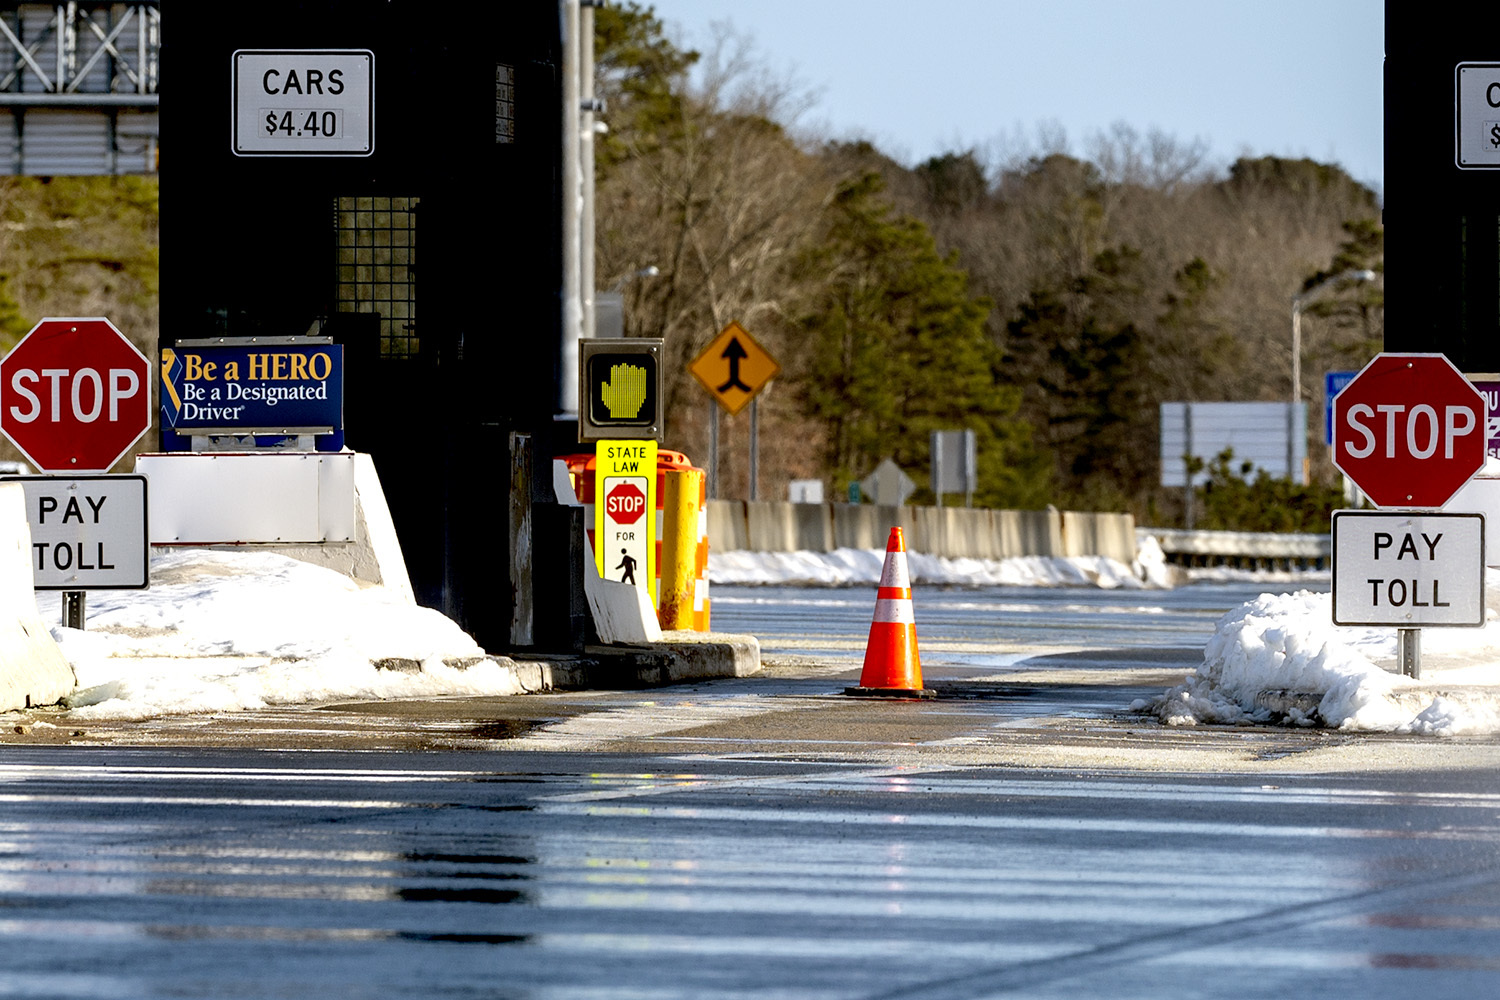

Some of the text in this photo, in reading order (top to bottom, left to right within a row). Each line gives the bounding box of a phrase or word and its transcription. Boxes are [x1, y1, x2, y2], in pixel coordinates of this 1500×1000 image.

[262, 68, 345, 96] CARS
[265, 110, 337, 137] $4.40
[183, 352, 333, 382] Be a HERO
[9, 367, 140, 424] STOP
[183, 380, 328, 406] Be a Designated
[1344, 403, 1477, 461] STOP
[607, 446, 647, 459] STATE
[613, 461, 639, 473] LAW
[39, 495, 108, 525] PAY
[608, 495, 644, 513] STOP
[616, 531, 635, 541] FOR
[1373, 532, 1444, 562] PAY
[33, 541, 115, 571] TOLL
[1366, 578, 1451, 608] TOLL
